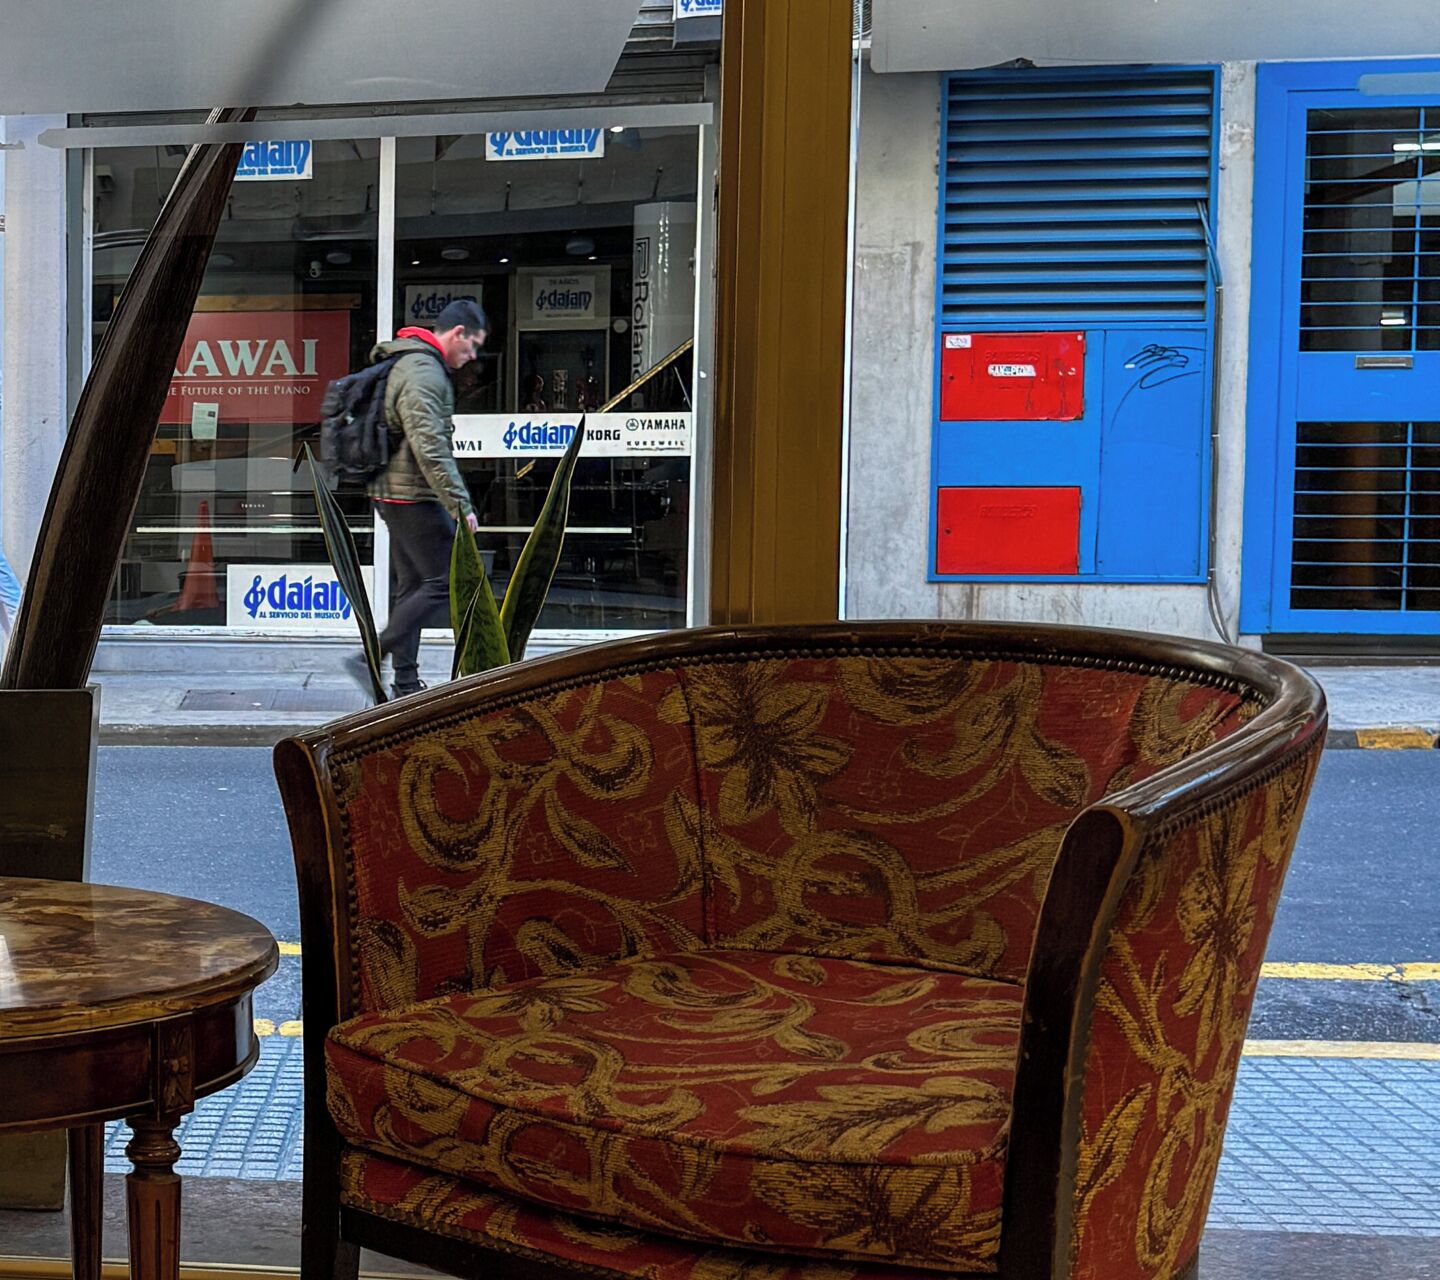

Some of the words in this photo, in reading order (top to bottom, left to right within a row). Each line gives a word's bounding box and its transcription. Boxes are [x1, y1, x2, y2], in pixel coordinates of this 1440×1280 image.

[173, 338, 319, 377] AWAI
[587, 429, 621, 441] KORG
[640, 419, 686, 430] YAMAHA
[269, 611, 299, 619] SERVICIO
[301, 611, 312, 619] DEL
